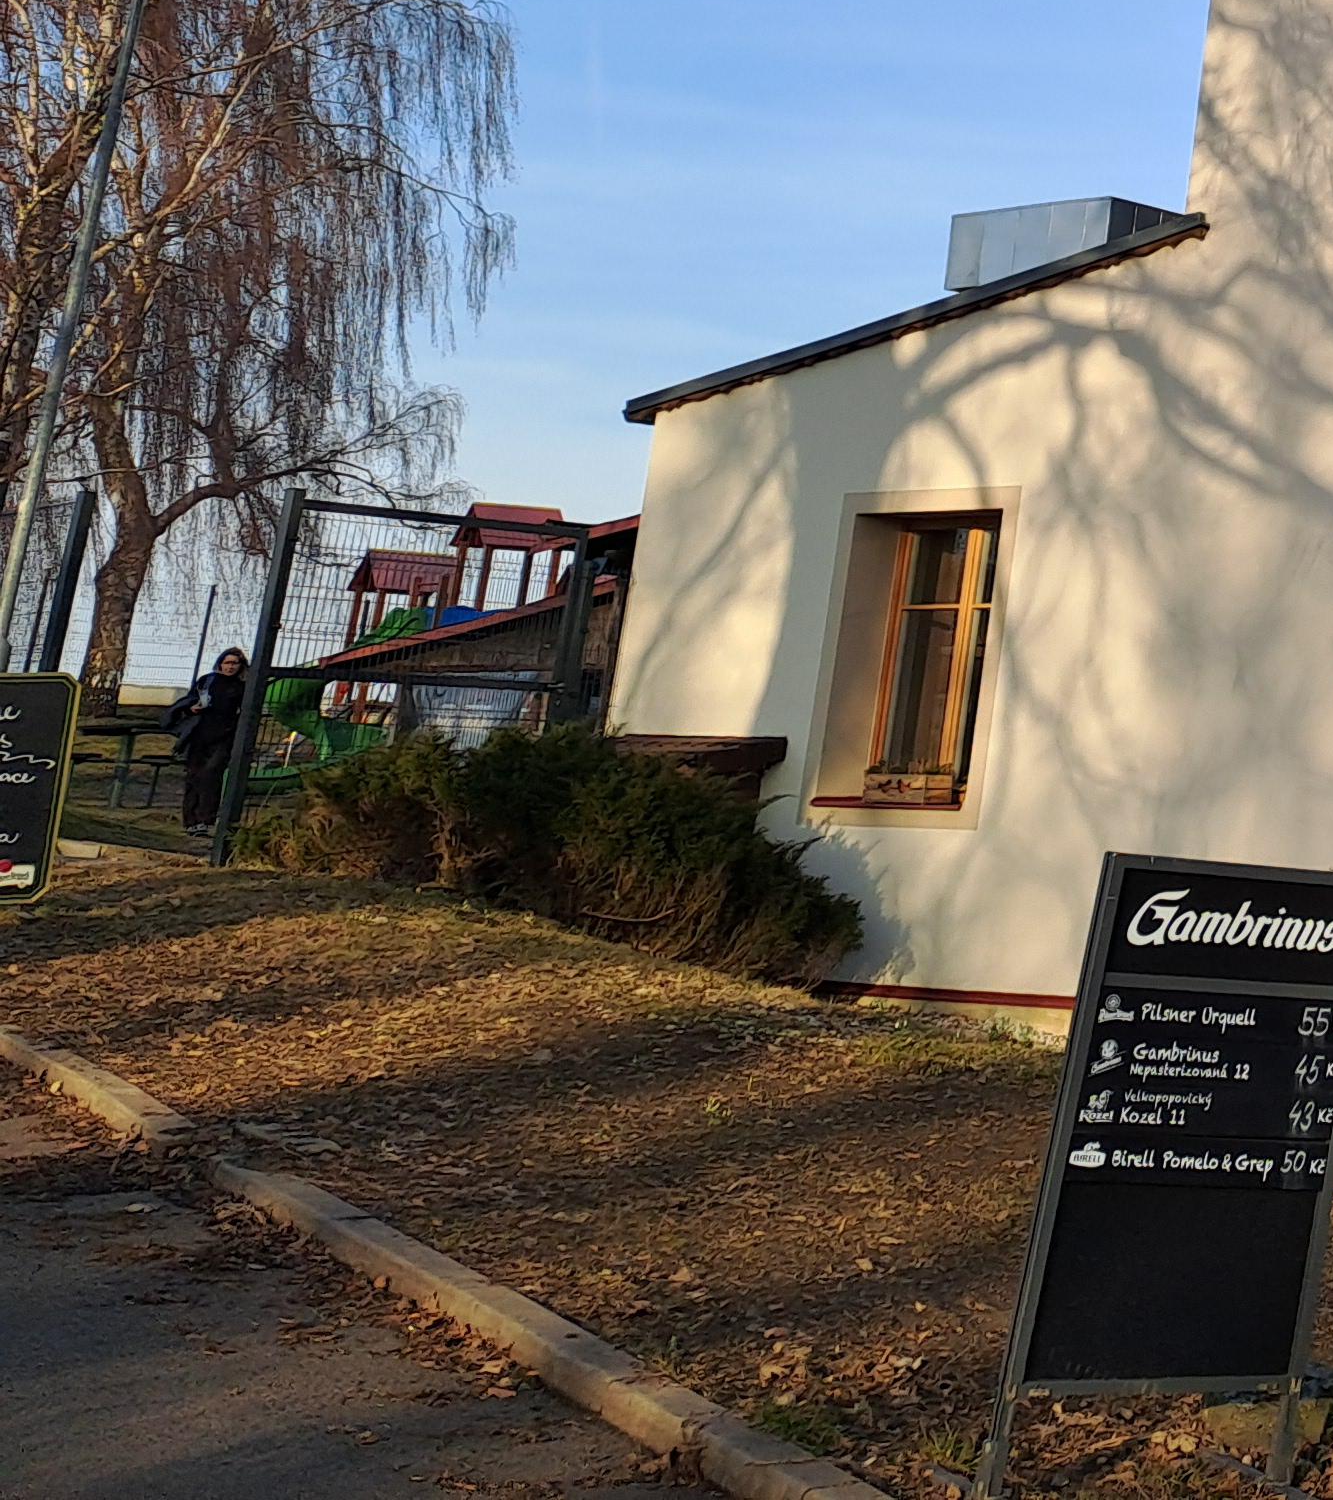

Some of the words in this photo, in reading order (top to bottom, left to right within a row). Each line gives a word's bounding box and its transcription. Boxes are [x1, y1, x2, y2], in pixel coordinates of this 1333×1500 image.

[1141, 1002, 1197, 1024] Pilsner
[1201, 1006, 1256, 1034] Urquell
[1298, 1007, 1331, 1036] 55
[1133, 1040, 1219, 1064] Gambrinus
[1129, 1062, 1228, 1083] Nepasterizovaná
[1233, 1063, 1250, 1081] 12
[1295, 1054, 1325, 1085] 45
[1124, 1088, 1213, 1112] Velkopopovický
[1078, 1109, 1115, 1123] Kozel
[1119, 1106, 1163, 1125] Kozel
[1169, 1108, 1186, 1125] 11
[1288, 1100, 1316, 1133] 43
[1317, 1108, 1333, 1124] Kč
[1111, 1149, 1155, 1168] Birell
[1163, 1150, 1219, 1170] Pomelo
[1235, 1154, 1274, 1183] Grep
[1280, 1150, 1307, 1174] 50
[1309, 1158, 1326, 1175] Kč
